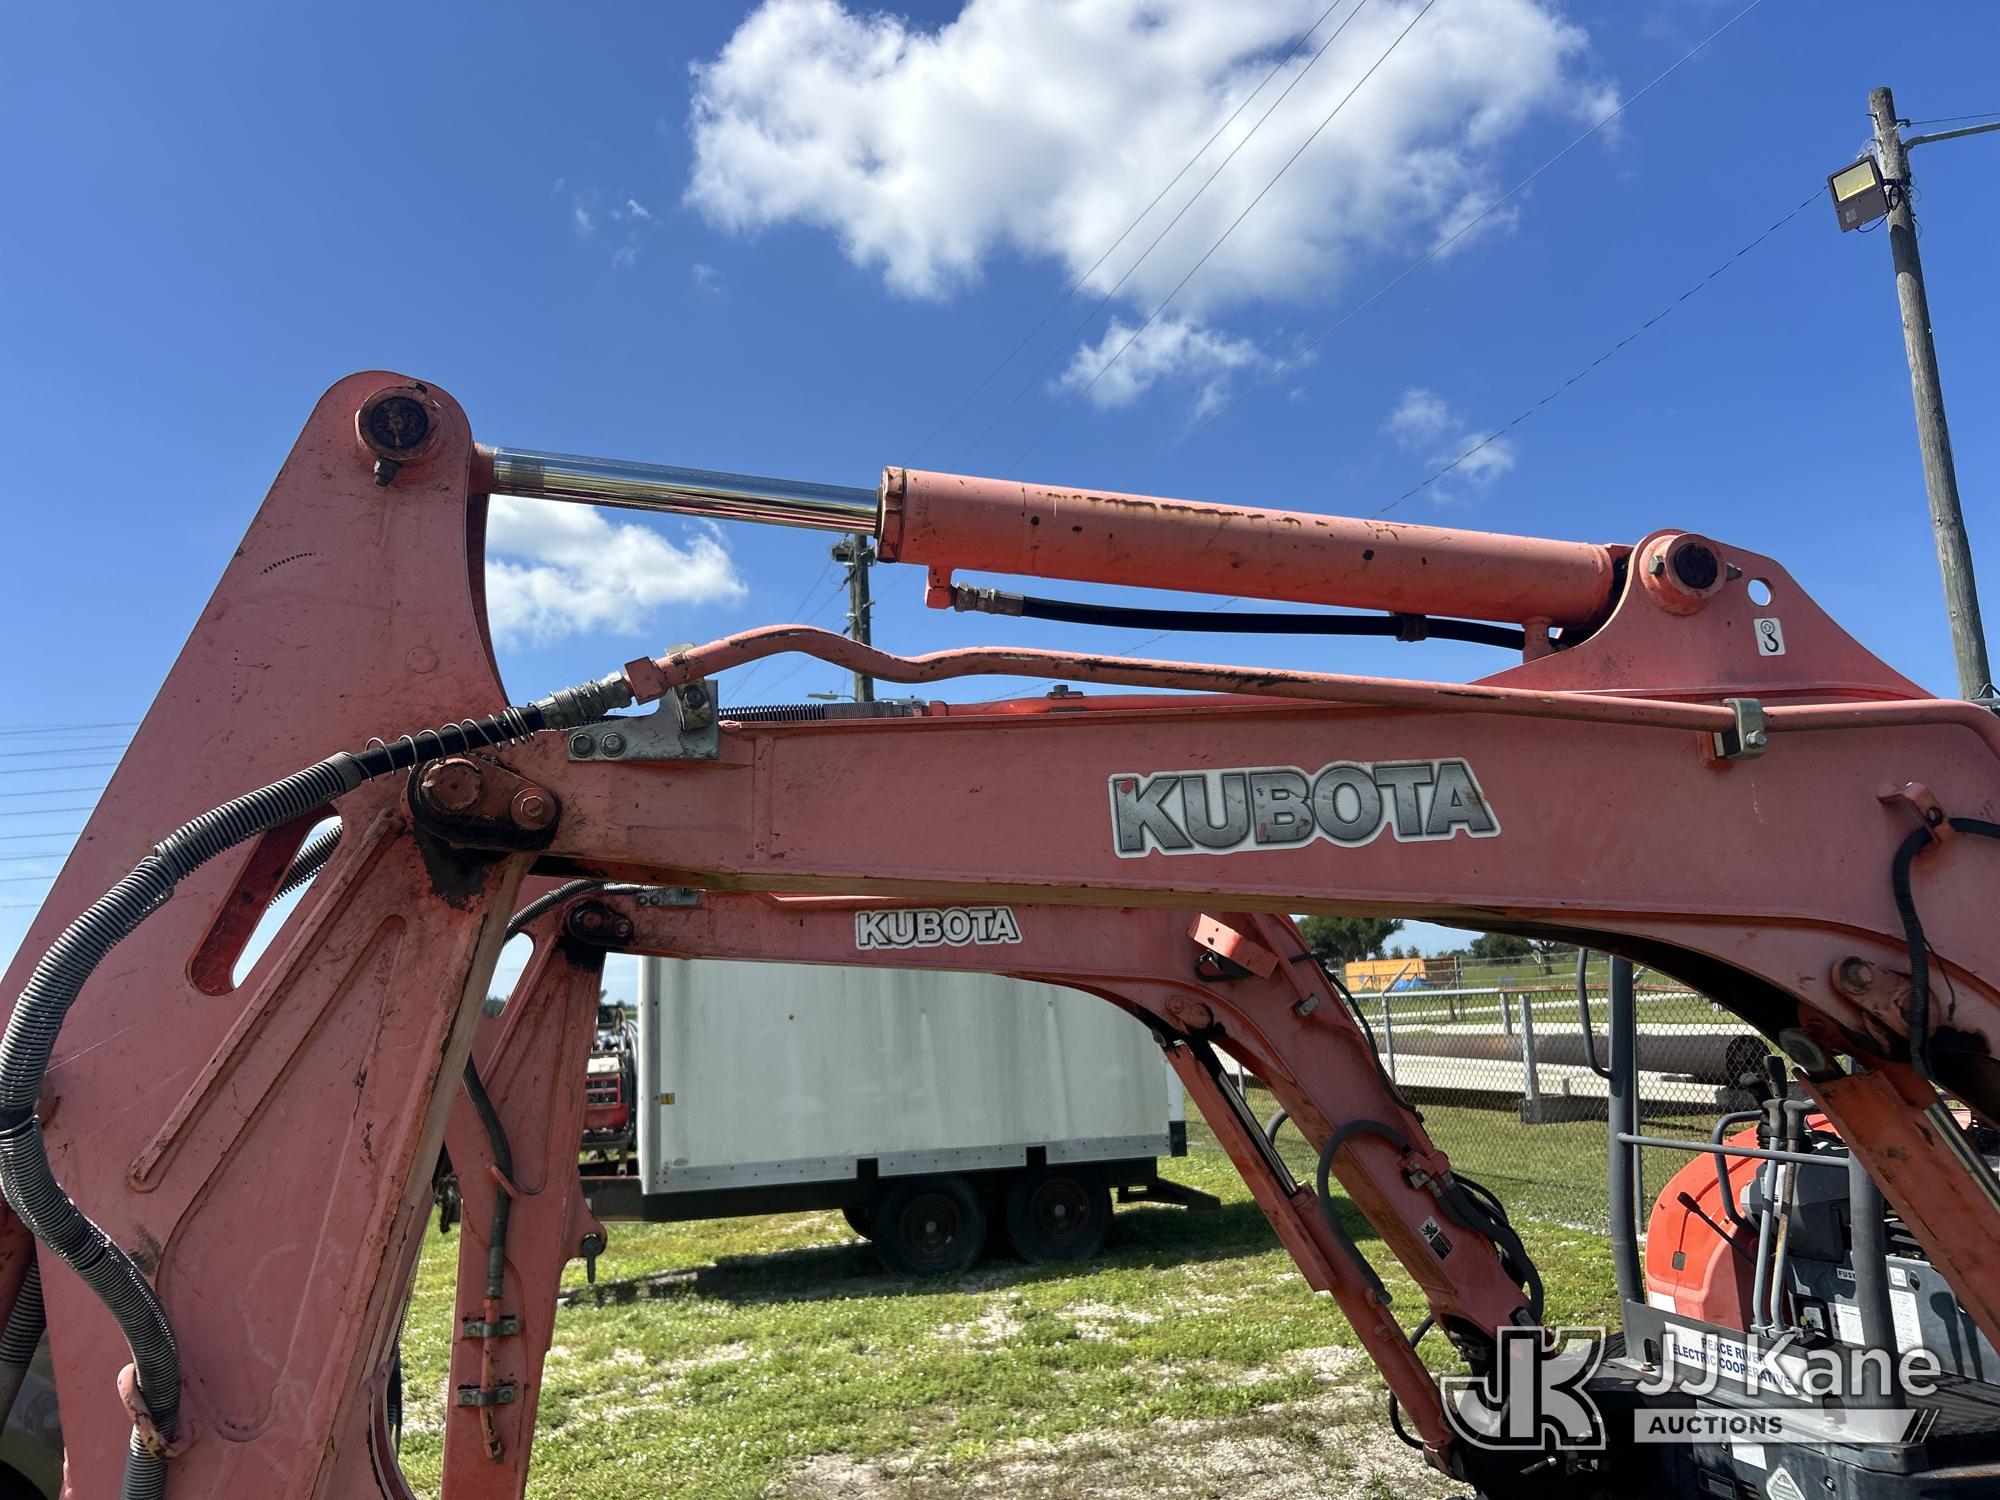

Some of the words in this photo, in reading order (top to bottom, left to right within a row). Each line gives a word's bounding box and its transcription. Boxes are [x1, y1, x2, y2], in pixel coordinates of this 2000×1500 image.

[1111, 760, 1499, 855] KUBOTA
[857, 908, 1019, 947] KUBOTA
[1673, 1343, 1717, 1367] ELECTRIC
[1719, 1357, 1791, 1389] COOPERATIVE
[1701, 1337, 1733, 1357] PEACE
[1735, 1347, 1767, 1367] RIVER
